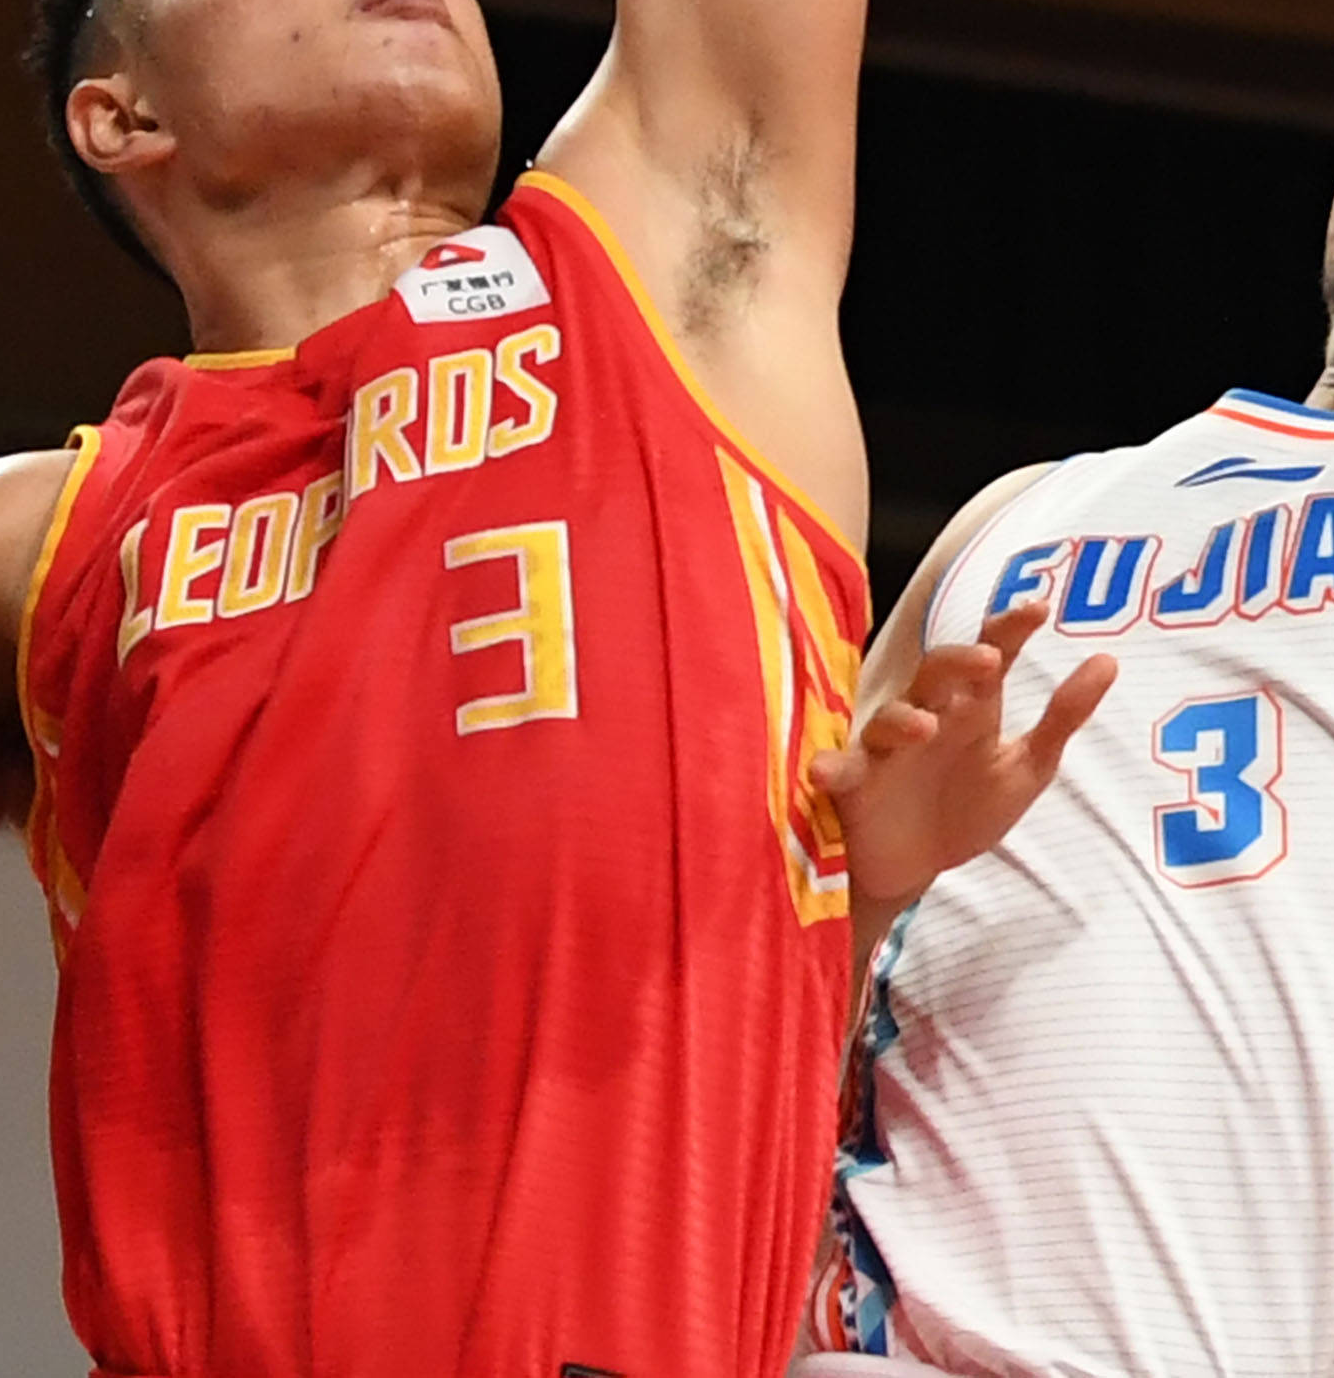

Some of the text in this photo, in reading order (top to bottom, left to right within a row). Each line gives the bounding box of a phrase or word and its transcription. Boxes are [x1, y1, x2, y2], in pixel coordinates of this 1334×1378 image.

[447, 293, 506, 315] CGB
[118, 323, 561, 670] LEOPRDS
[444, 520, 579, 737] 3
[1151, 686, 1289, 889] 3
